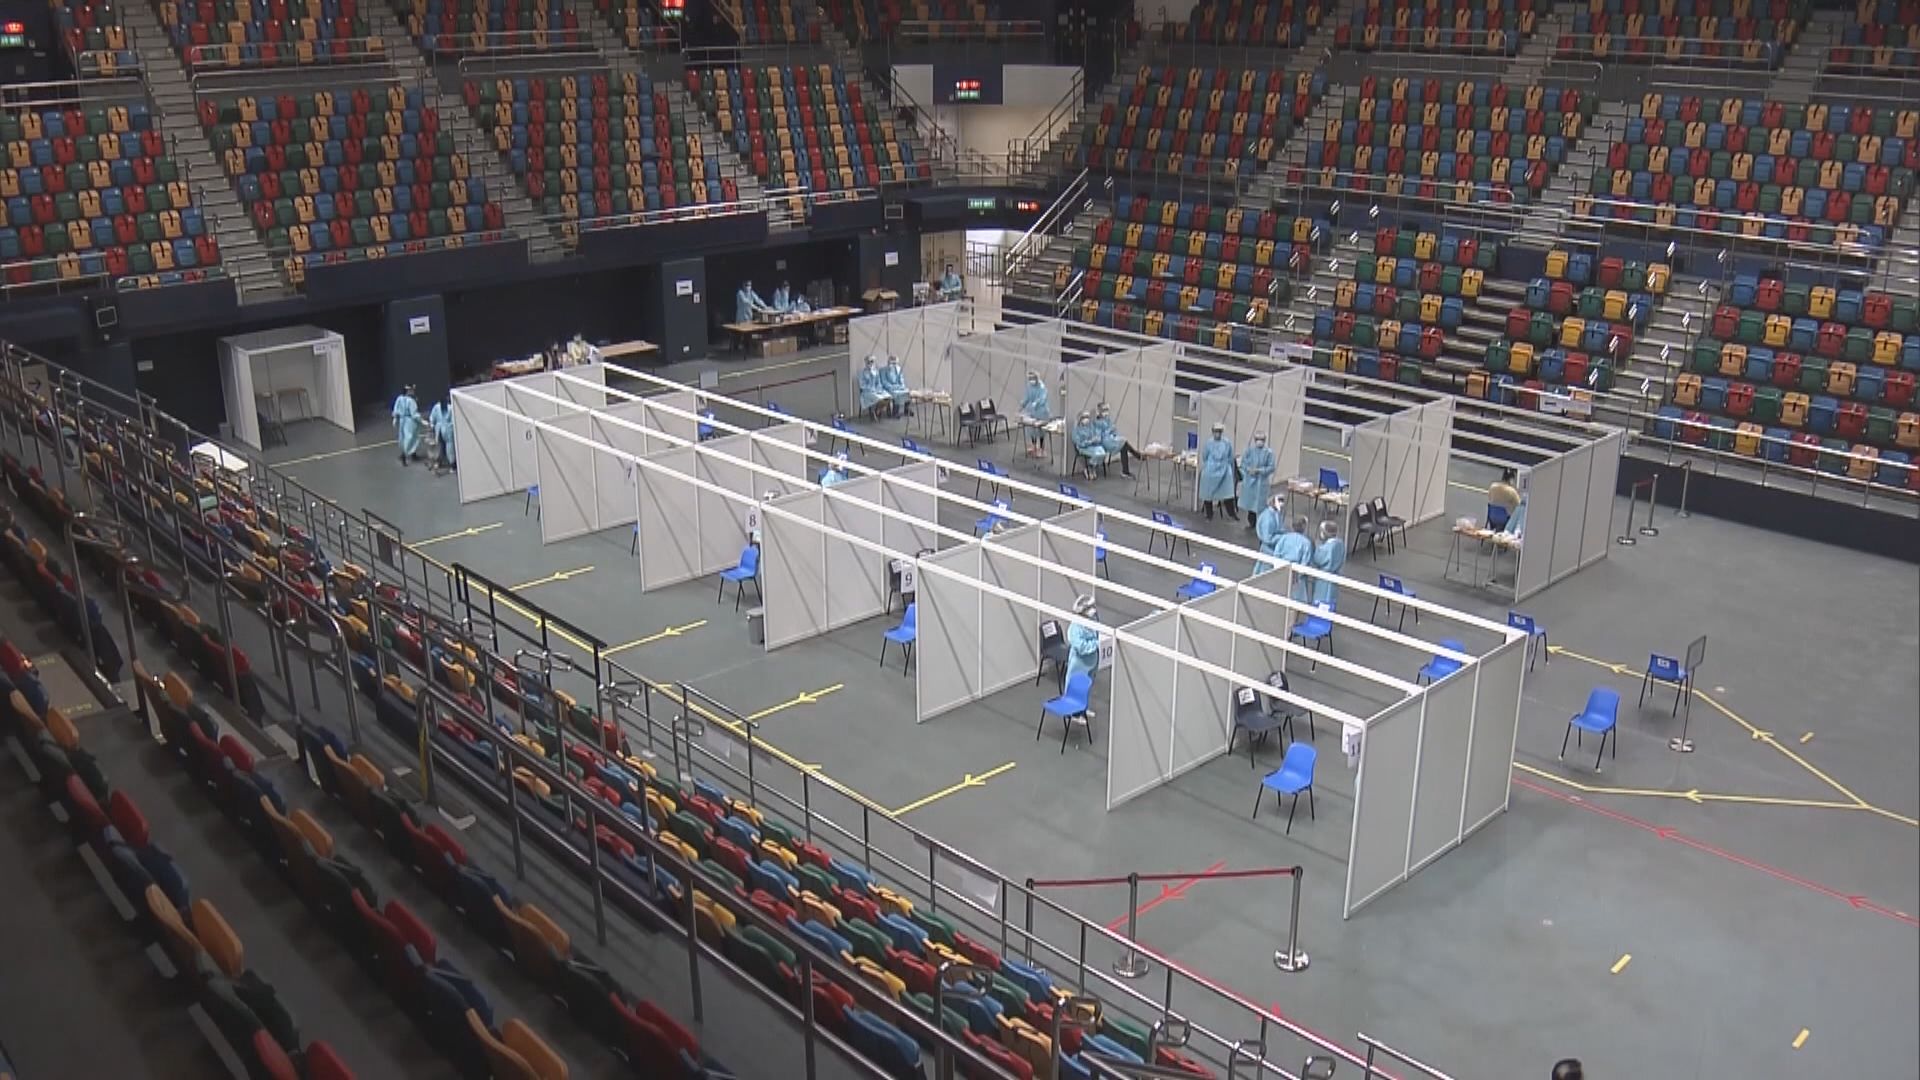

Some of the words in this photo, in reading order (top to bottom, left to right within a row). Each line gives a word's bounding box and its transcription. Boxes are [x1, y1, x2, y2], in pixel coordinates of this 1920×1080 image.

[525, 430, 532, 441] 6
[749, 513, 757, 527] 8
[905, 572, 913, 586] 9
[1102, 646, 1113, 660] 10
